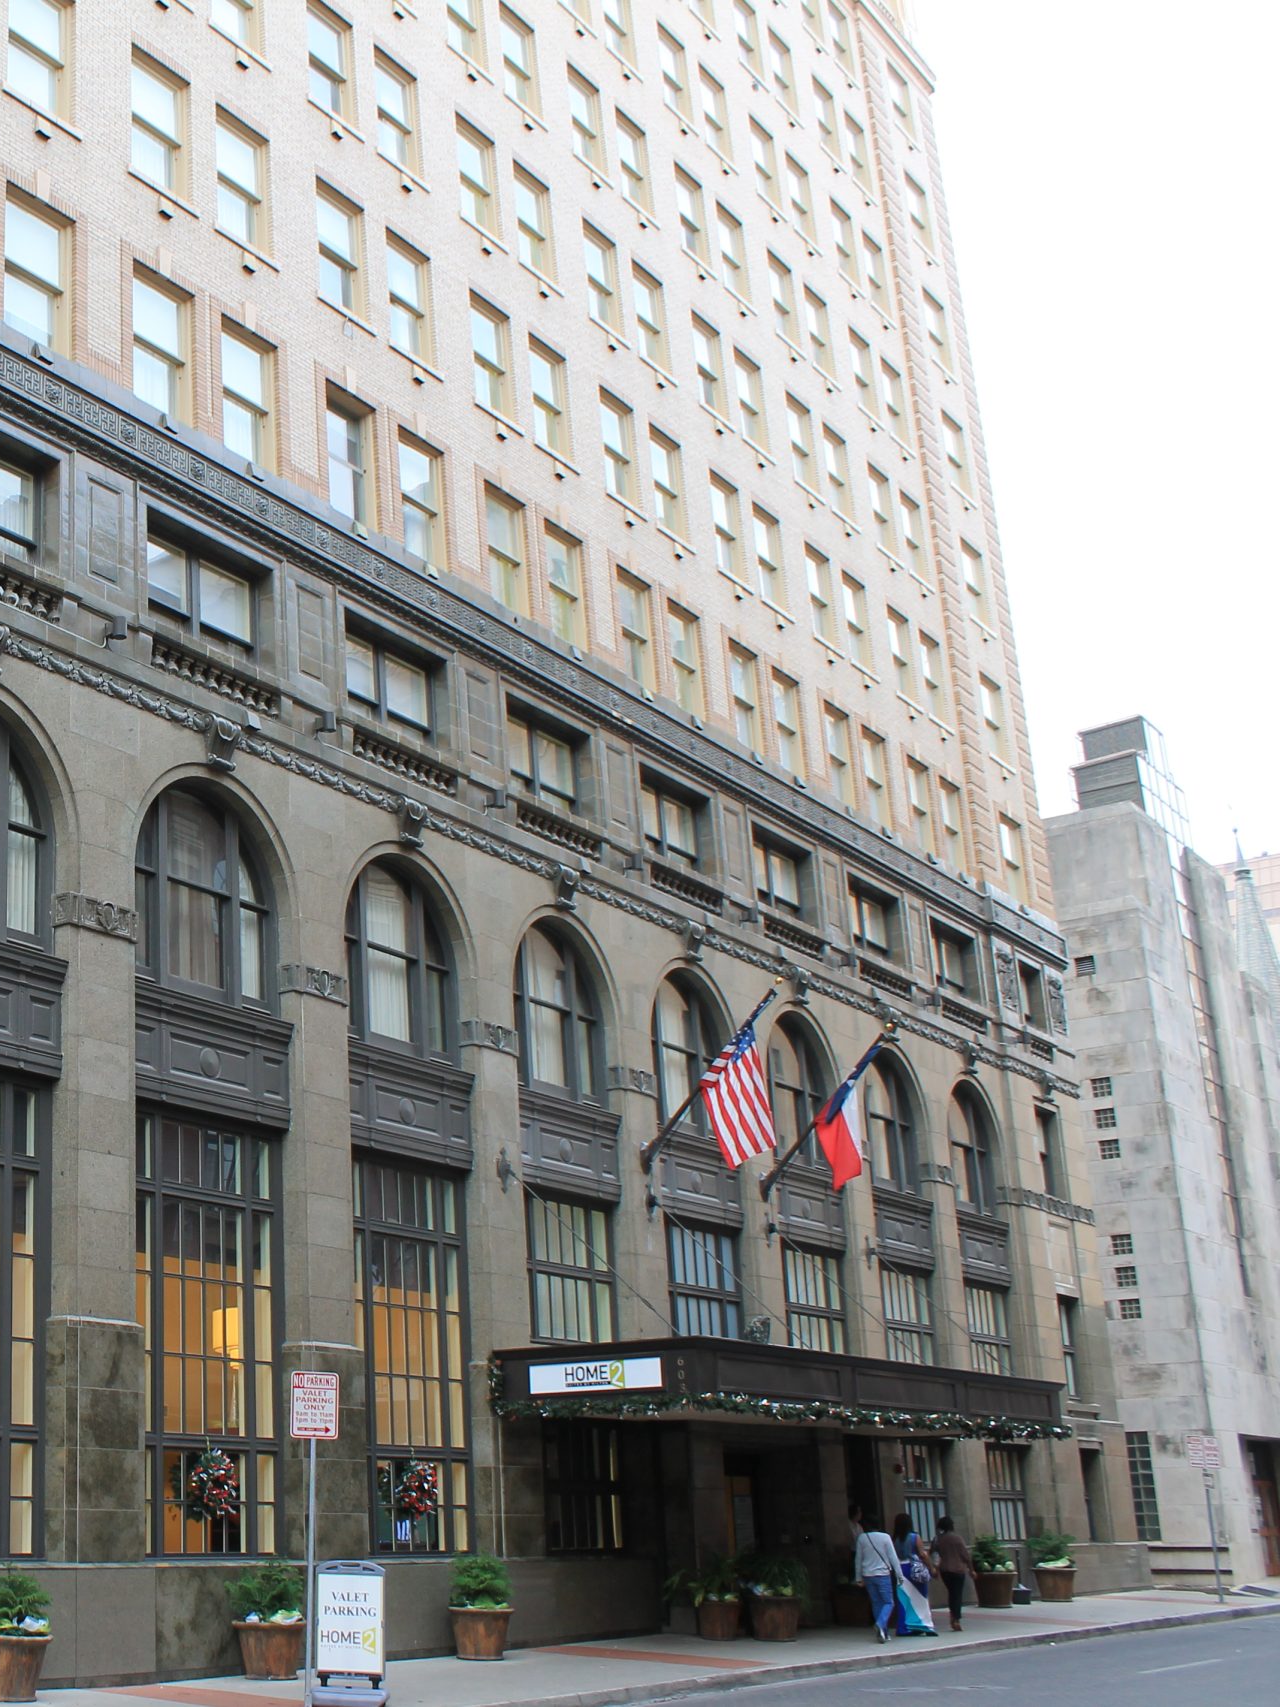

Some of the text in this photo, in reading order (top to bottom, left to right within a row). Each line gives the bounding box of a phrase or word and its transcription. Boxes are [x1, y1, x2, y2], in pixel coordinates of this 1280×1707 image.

[293, 1374, 335, 1387] NO PARKING
[331, 1591, 370, 1603] VALET
[323, 1605, 377, 1617] PARKING
